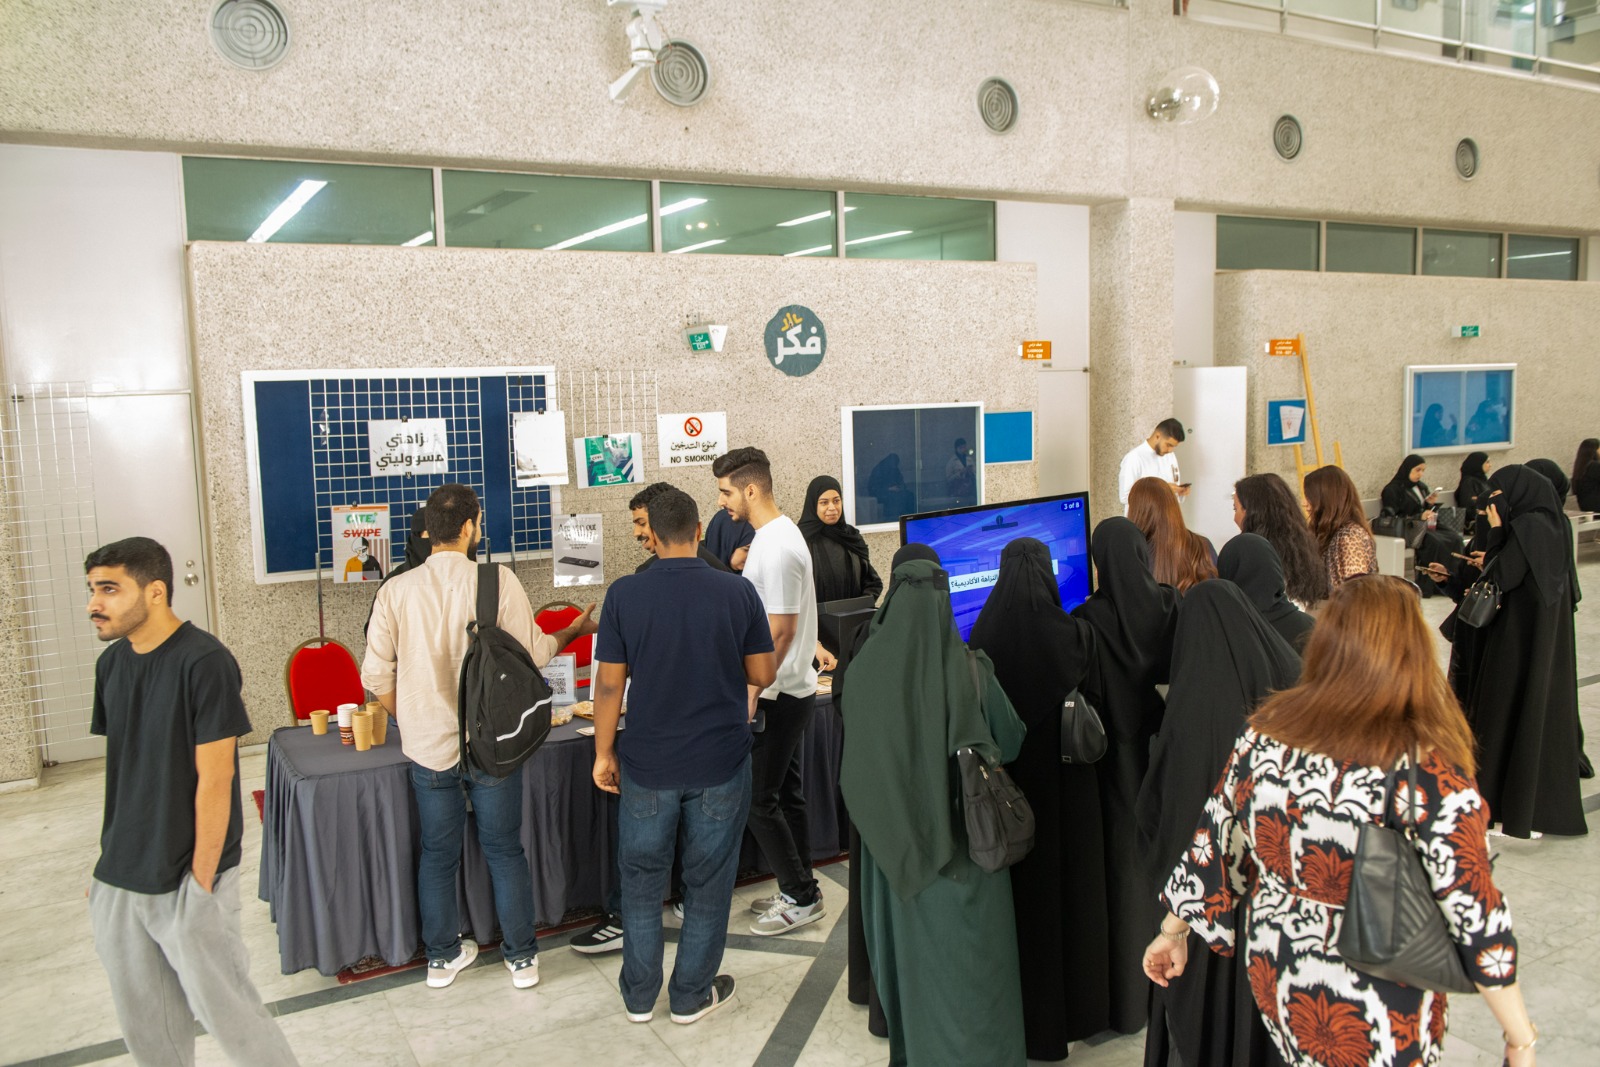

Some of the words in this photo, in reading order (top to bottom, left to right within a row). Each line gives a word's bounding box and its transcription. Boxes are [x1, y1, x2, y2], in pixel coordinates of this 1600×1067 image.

[774, 324, 821, 365] فكر
[386, 432, 428, 451] زاهتي
[685, 454, 718, 462] SMOKING
[343, 528, 381, 538] SWIPE
